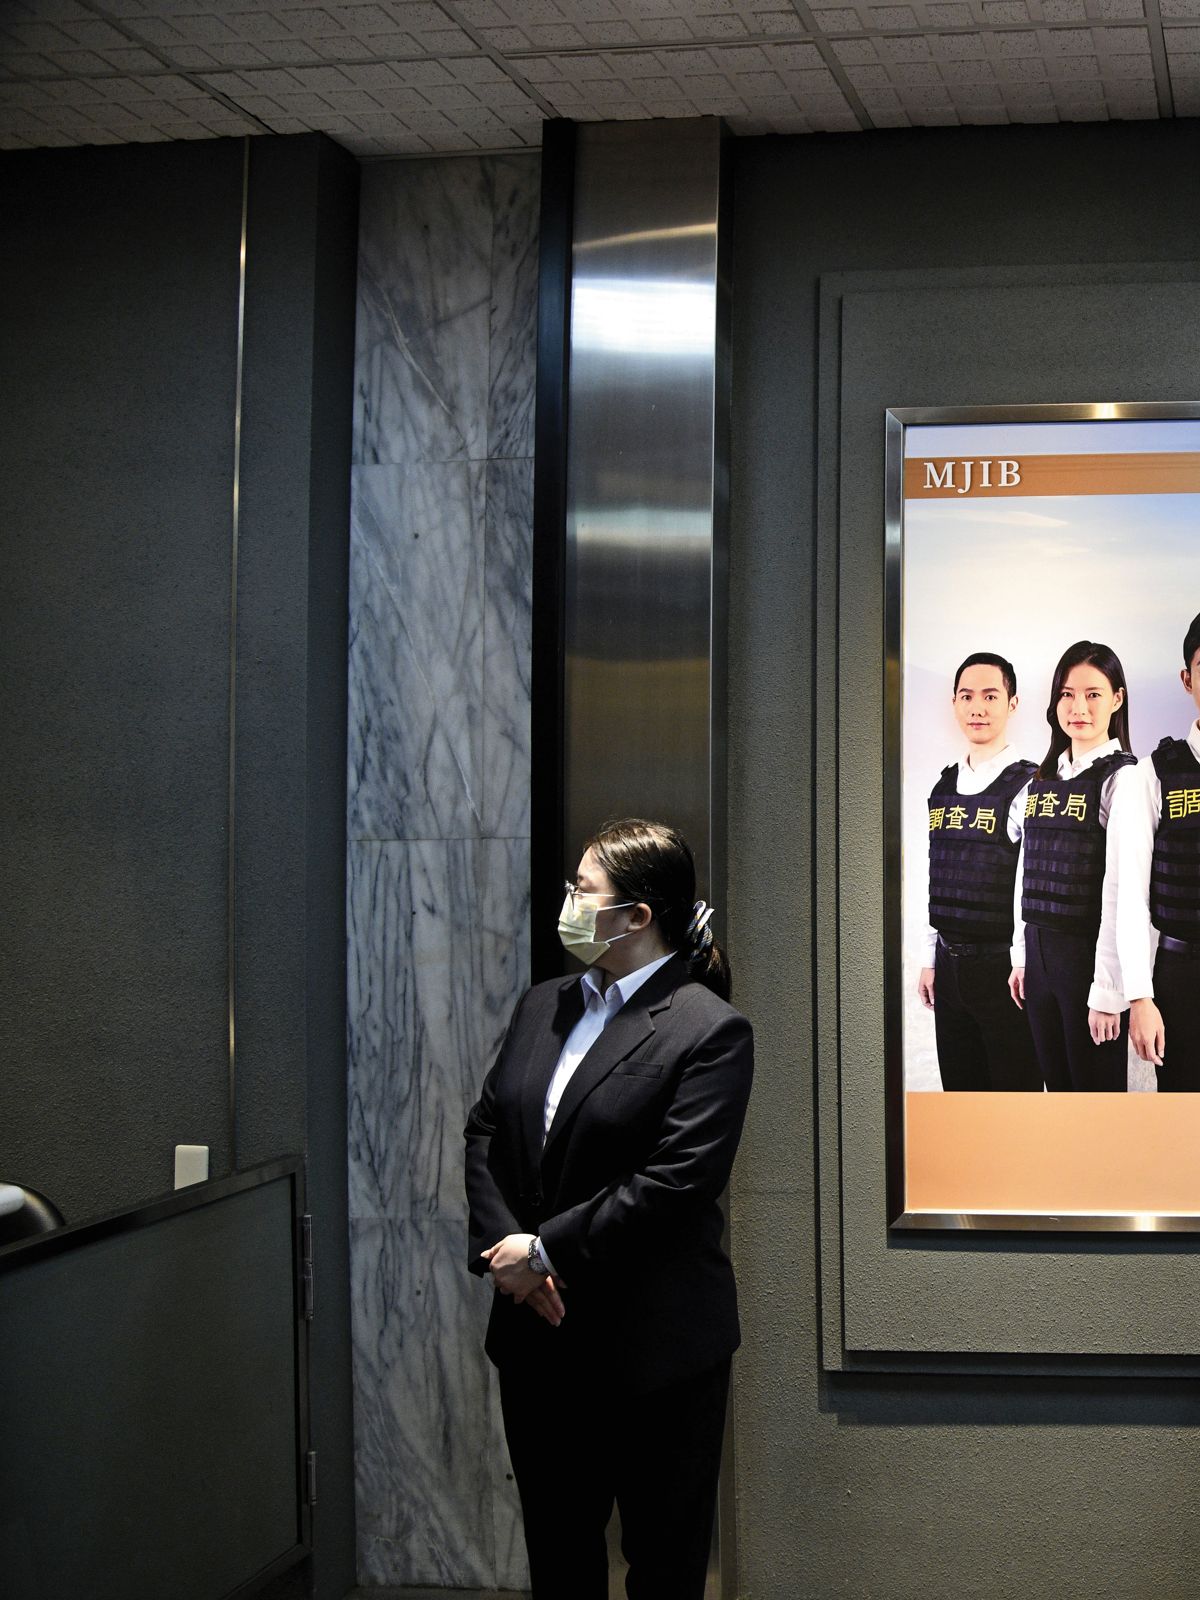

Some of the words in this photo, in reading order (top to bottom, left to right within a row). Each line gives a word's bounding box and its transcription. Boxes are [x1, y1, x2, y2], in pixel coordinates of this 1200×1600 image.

[923, 460, 1021, 494] MJIB
[929, 804, 997, 834] 調查局
